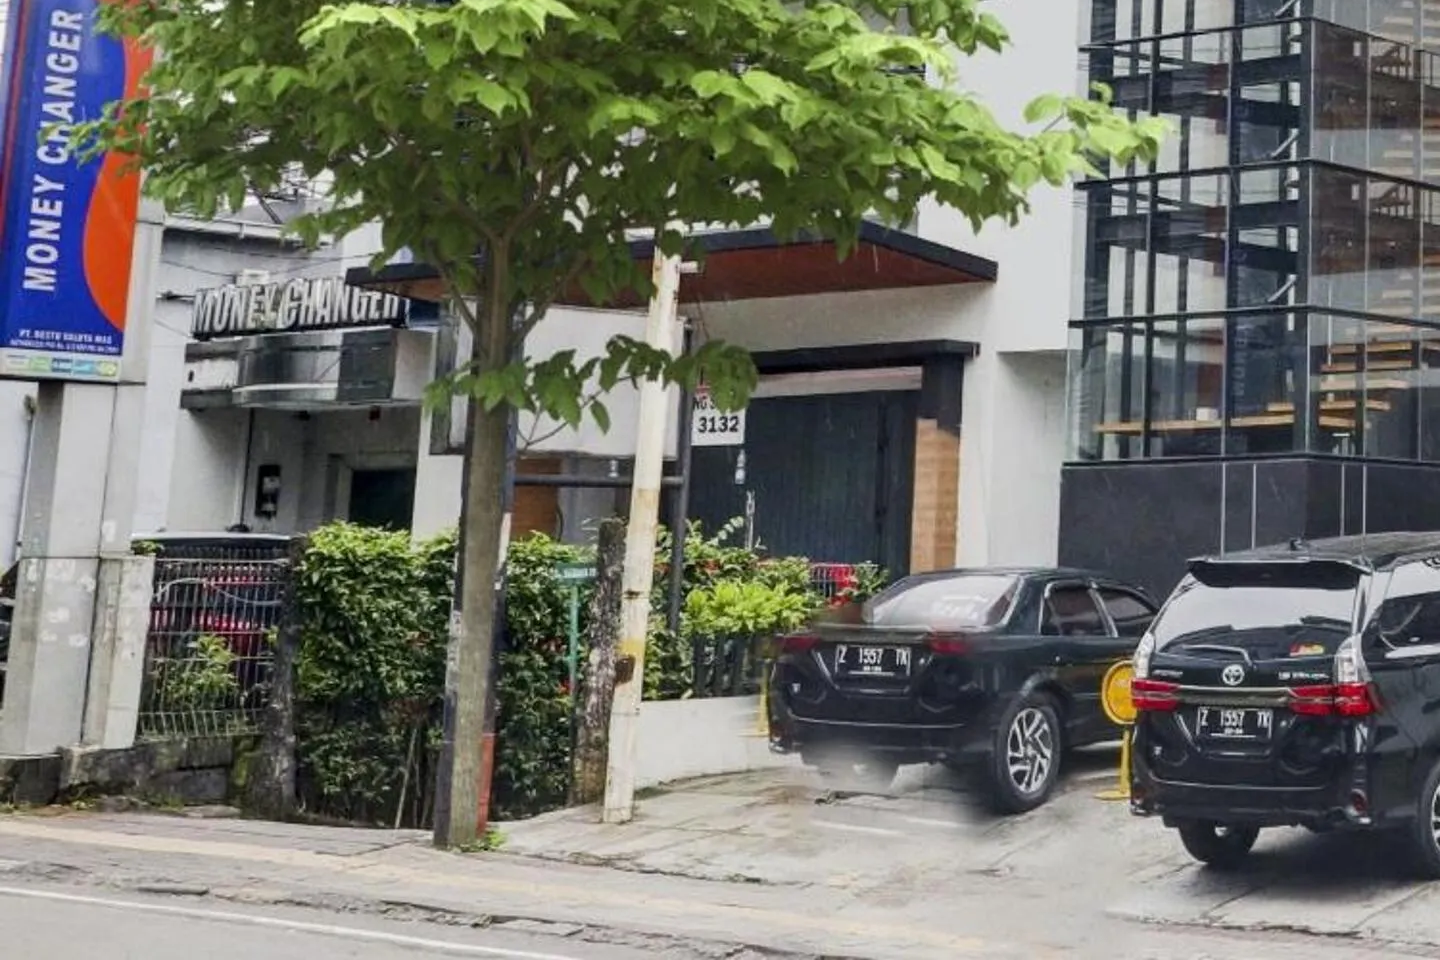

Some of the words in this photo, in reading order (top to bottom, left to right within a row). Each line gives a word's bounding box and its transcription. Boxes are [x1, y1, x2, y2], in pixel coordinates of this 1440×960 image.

[36, 9, 83, 165] CHANGER
[22, 173, 66, 293] MONEY
[192, 285, 279, 333] MONEY
[697, 416, 739, 433] 3132
[838, 645, 848, 663] Z
[859, 647, 883, 665] 1557
[1201, 709, 1208, 726] Z
[1221, 710, 1245, 727] 1557
